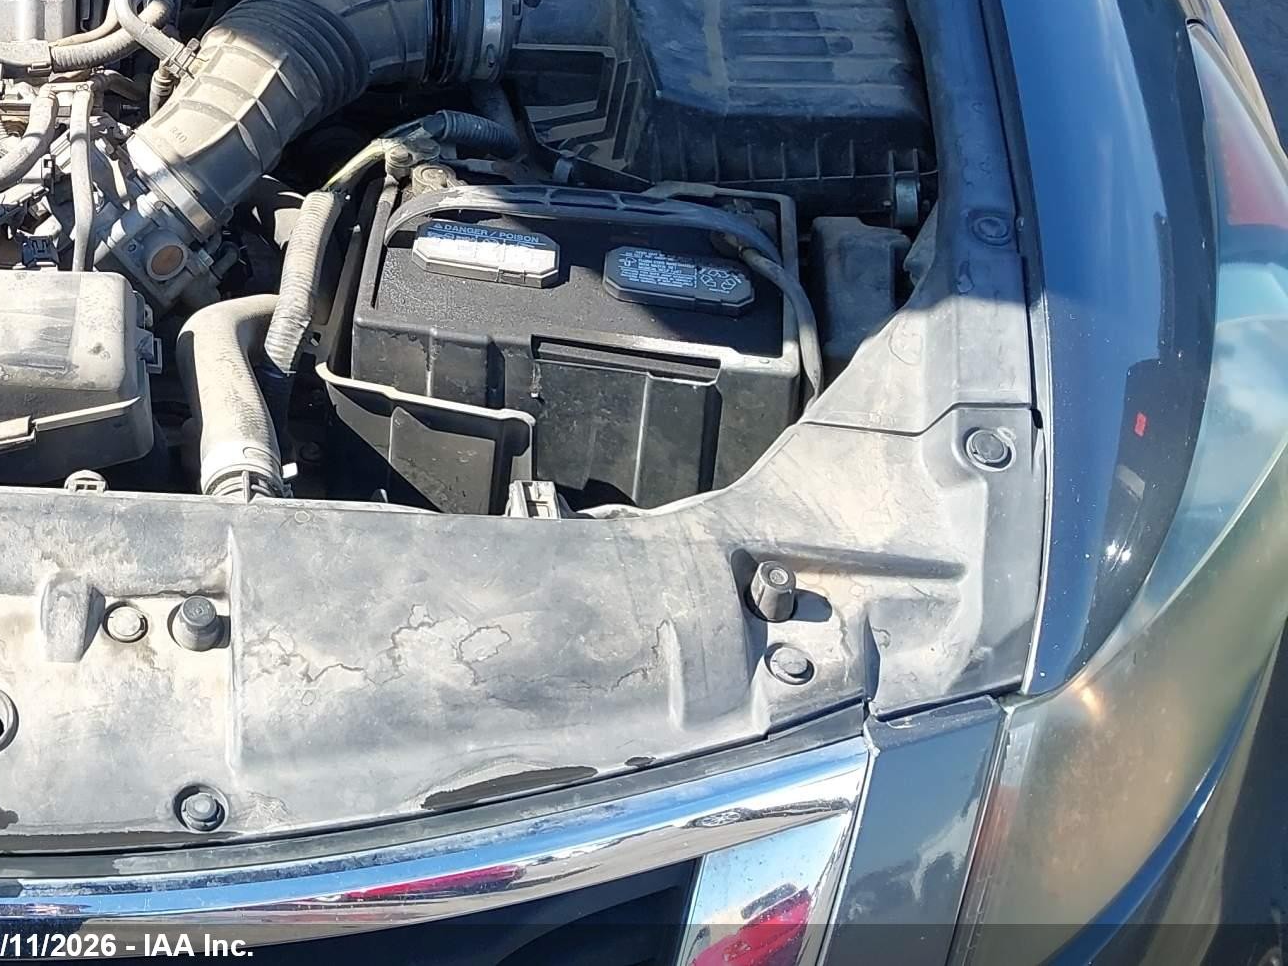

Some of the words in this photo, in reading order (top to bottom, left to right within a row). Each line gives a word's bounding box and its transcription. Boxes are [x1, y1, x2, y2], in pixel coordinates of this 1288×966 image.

[444, 224, 488, 236] DANGER
[489, 230, 498, 238] /
[498, 232, 540, 244] POISON
